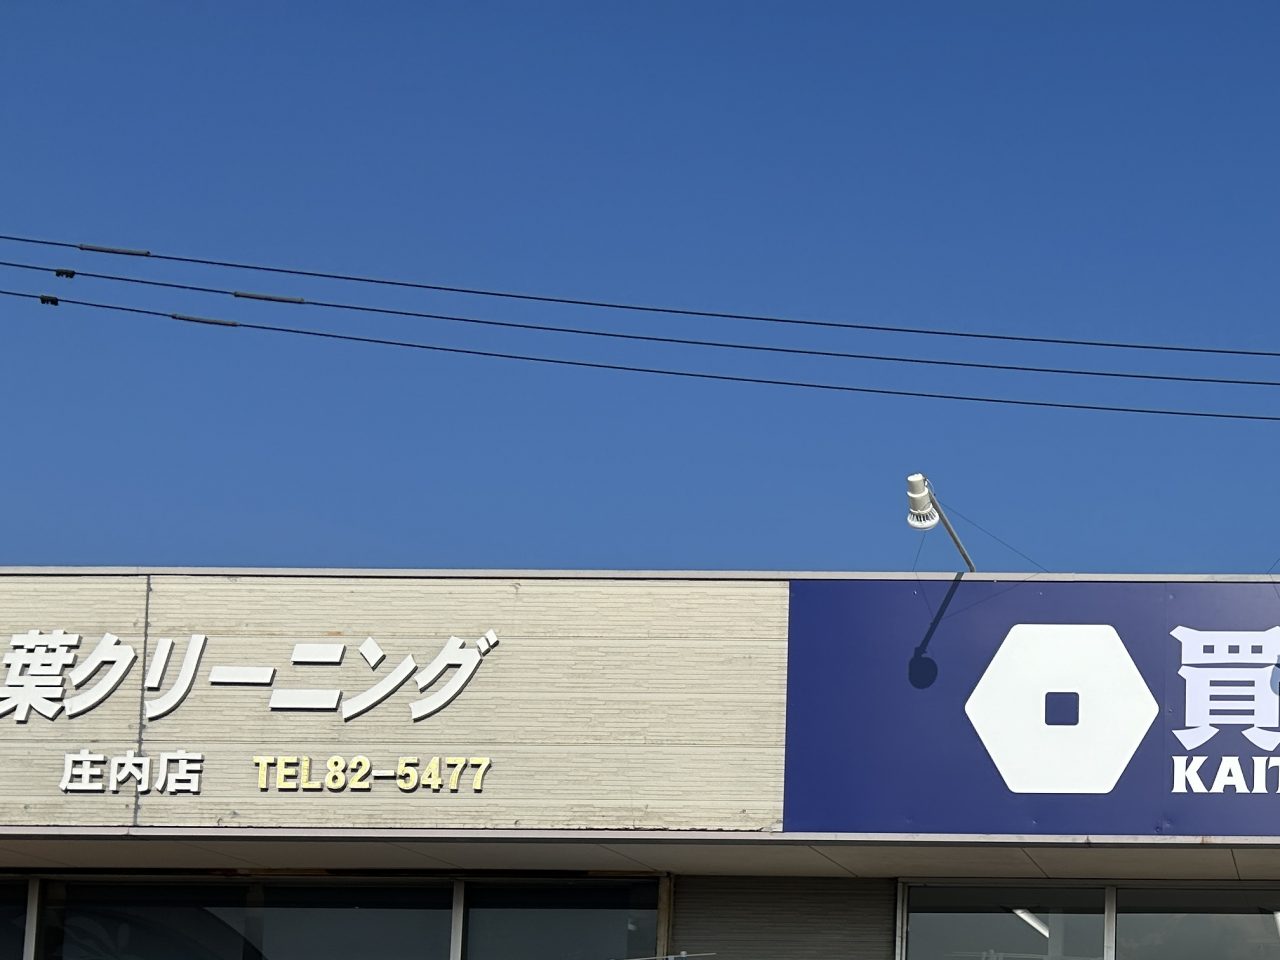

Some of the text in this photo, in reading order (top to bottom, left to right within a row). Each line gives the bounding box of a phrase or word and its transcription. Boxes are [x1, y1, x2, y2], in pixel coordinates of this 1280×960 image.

[0, 629, 500, 724] 葉クリーニング
[59, 750, 205, 794] 庄内店
